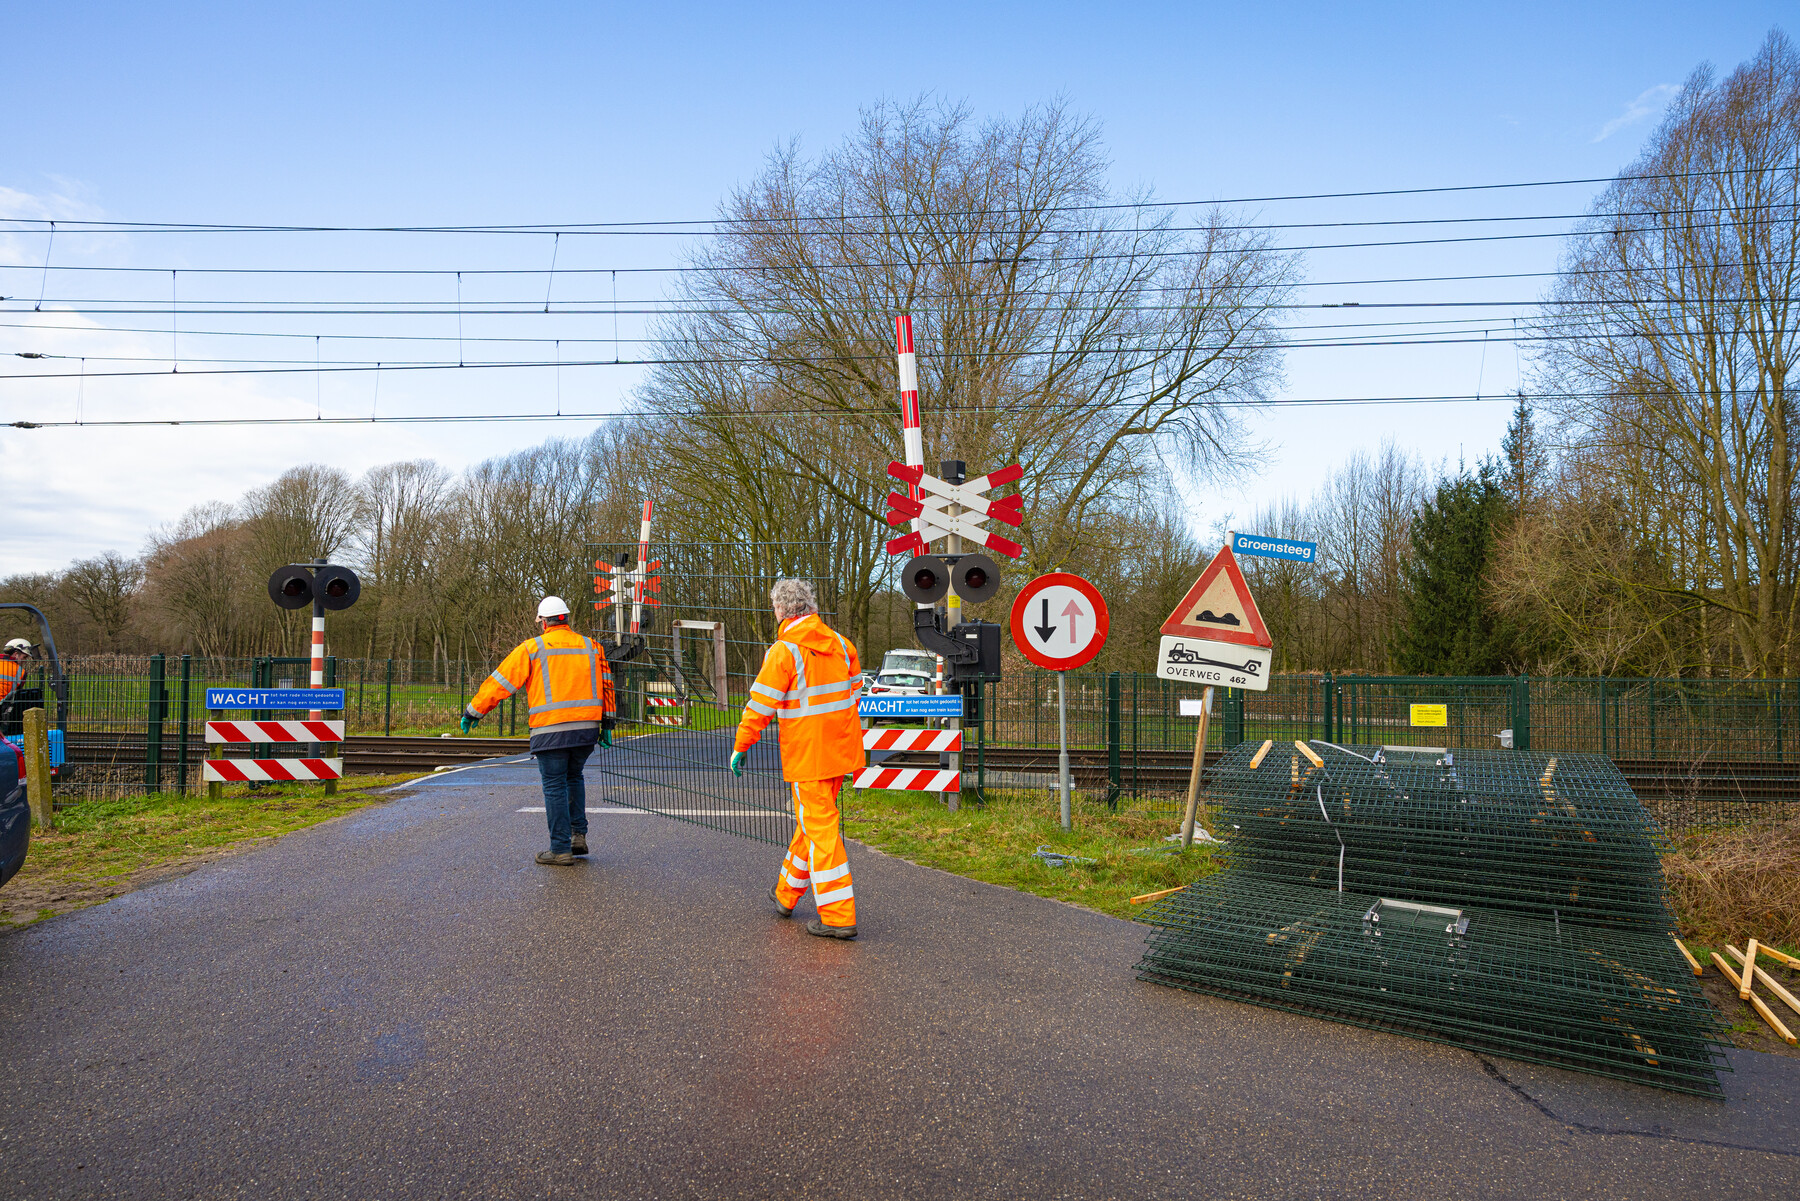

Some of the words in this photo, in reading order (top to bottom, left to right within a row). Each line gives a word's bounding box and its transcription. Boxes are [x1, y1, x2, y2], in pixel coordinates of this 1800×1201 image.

[1237, 537, 1312, 559] Groensteeg
[1166, 666, 1221, 681] OVERWEG
[1229, 676, 1247, 685] 462
[211, 693, 269, 705] WACHT
[858, 700, 905, 713] WACHT
